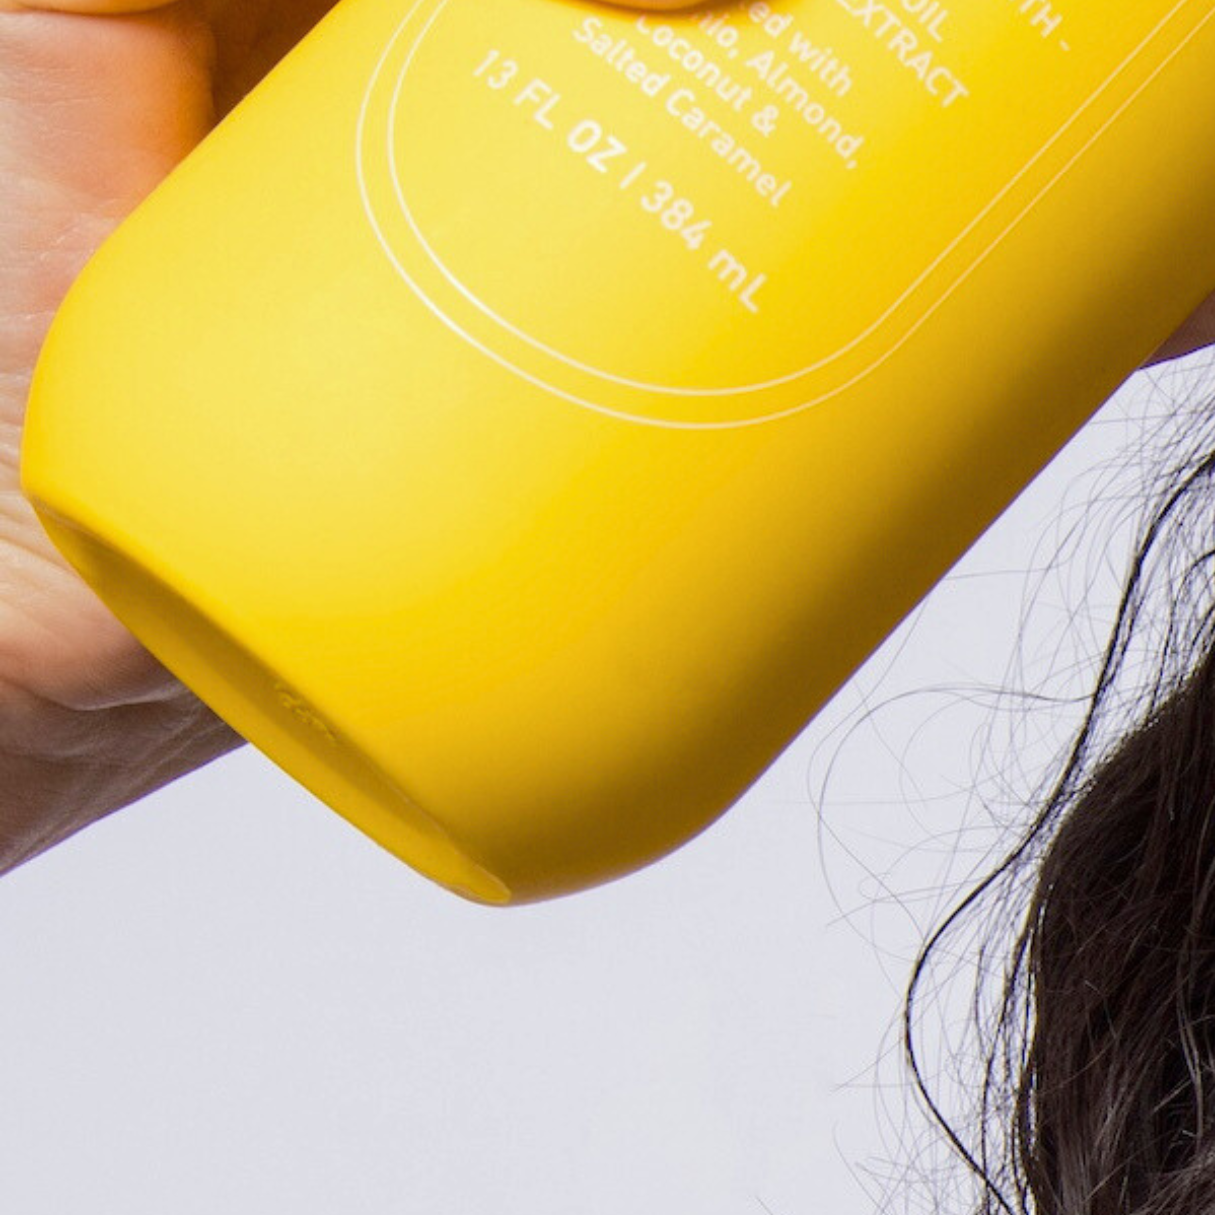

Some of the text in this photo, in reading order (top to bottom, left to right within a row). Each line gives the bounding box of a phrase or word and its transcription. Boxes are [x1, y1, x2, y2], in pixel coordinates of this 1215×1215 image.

[571, 15, 671, 98] Salted
[664, 87, 792, 208] Caramel
[744, 50, 865, 170] Almond,
[750, 104, 780, 138] &
[788, 30, 853, 97] with
[471, 48, 520, 90] 13
[512, 77, 561, 130] FL
[566, 118, 628, 174] OZ
[640, 179, 713, 251] 384
[706, 248, 768, 315] mL
